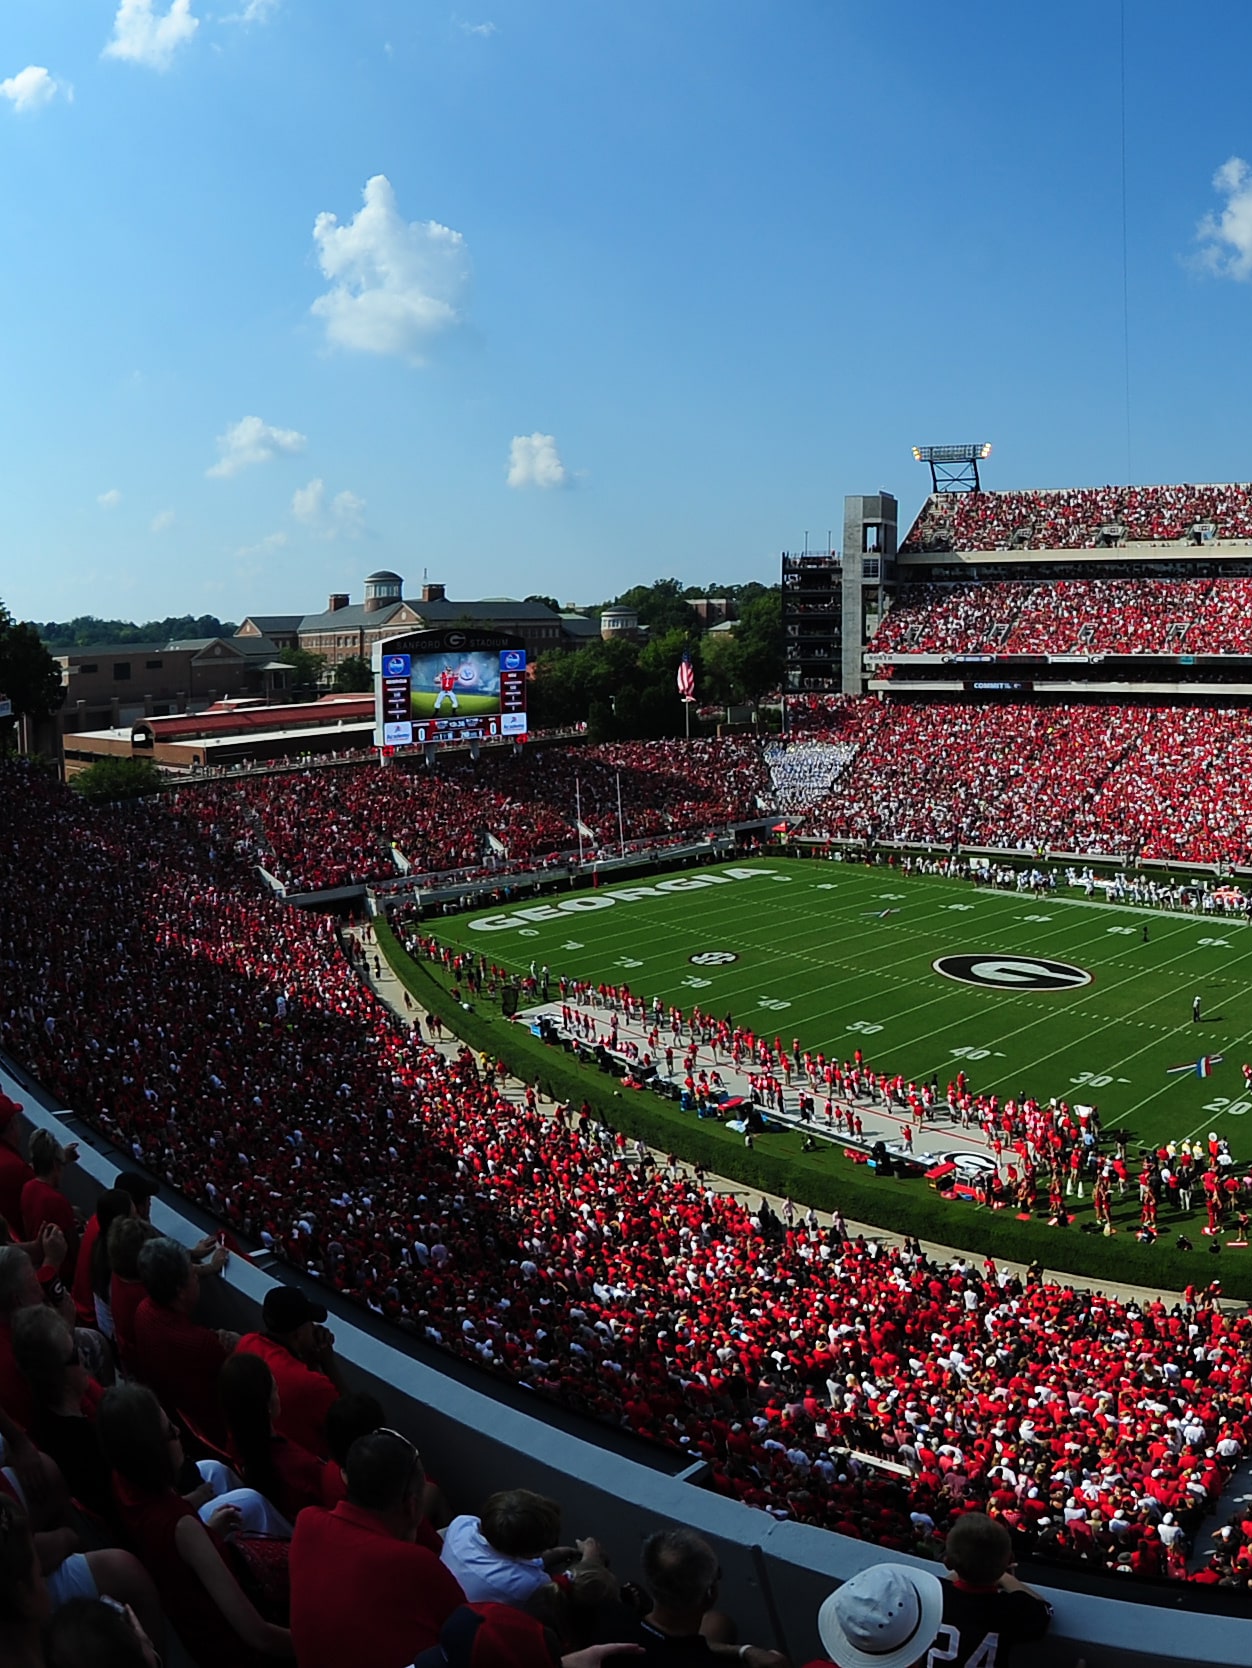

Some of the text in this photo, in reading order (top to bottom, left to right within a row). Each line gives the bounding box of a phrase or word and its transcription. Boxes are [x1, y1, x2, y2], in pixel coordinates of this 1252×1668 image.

[397, 640, 440, 649] SANFORD
[469, 639, 509, 648] STADIUM
[467, 866, 779, 932] GEORGIA
[757, 999, 792, 1011] 40
[845, 1020, 884, 1035] 50
[949, 1046, 991, 1060] 40
[1069, 1071, 1114, 1087] 30
[1202, 1097, 1252, 1115] 20
[927, 1623, 999, 1668] 24
